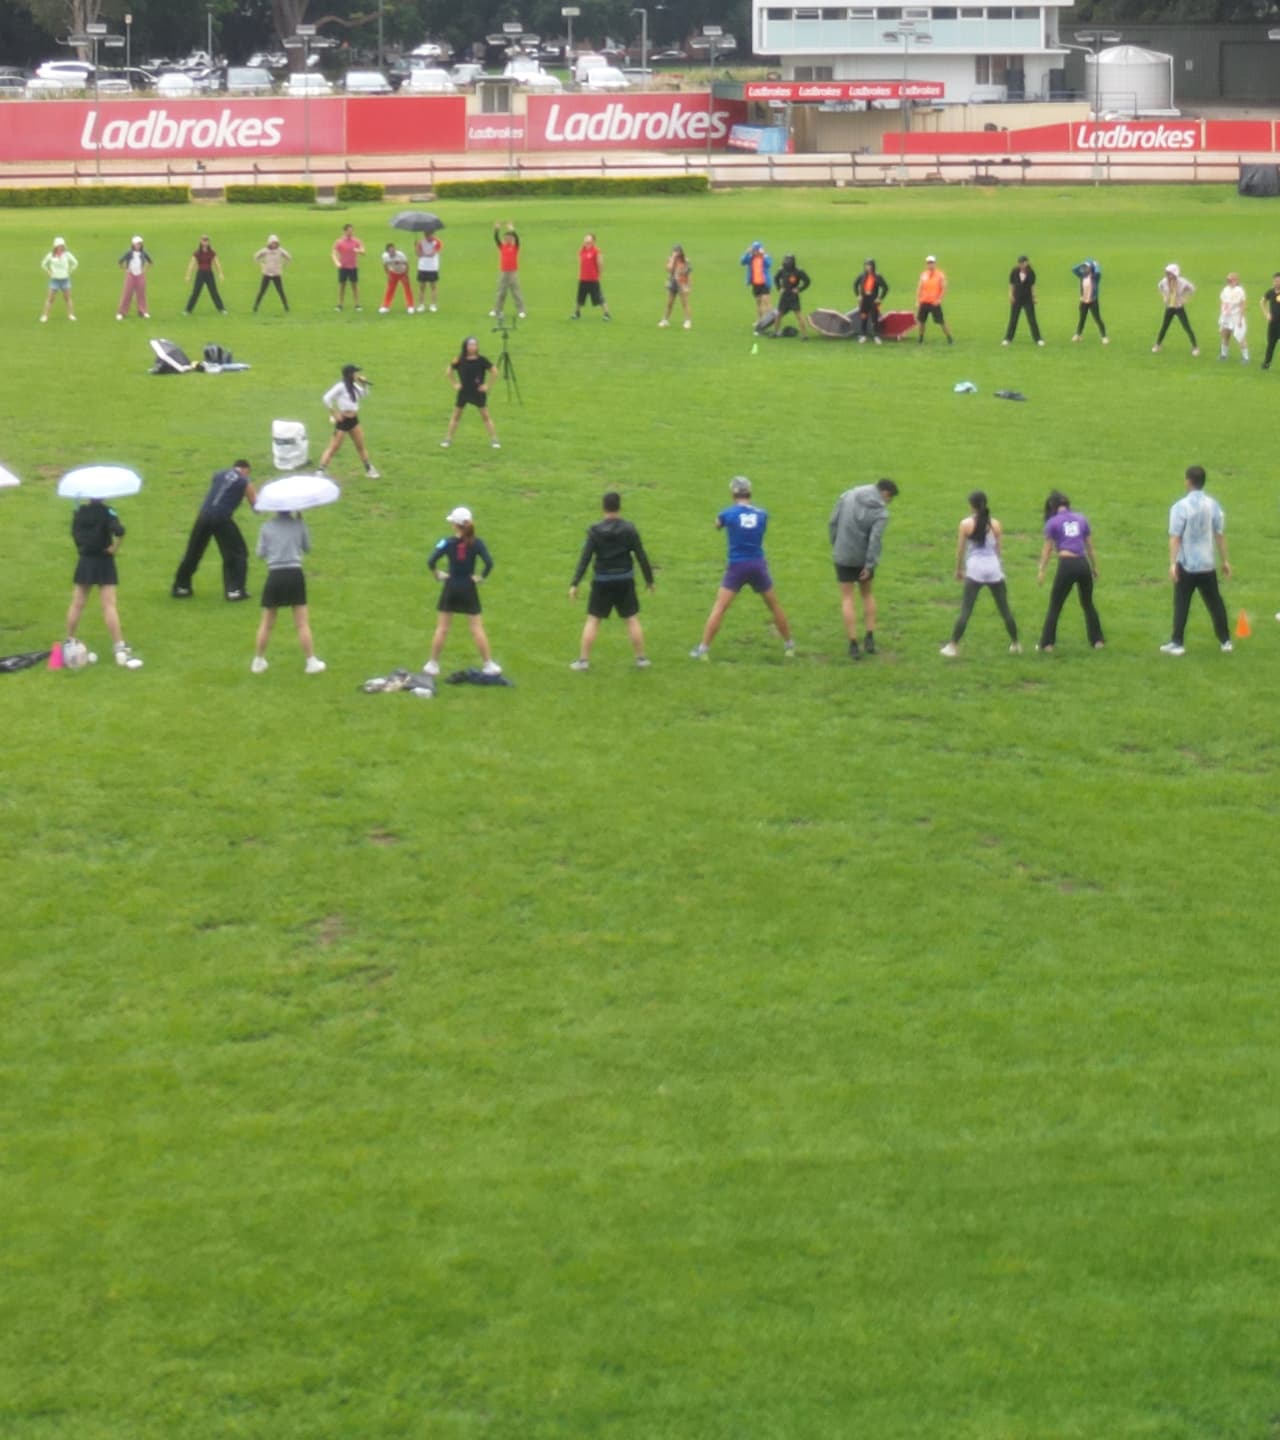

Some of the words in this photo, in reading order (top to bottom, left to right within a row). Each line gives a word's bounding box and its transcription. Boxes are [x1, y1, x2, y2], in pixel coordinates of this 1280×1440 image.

[80, 108, 285, 150] Ladbrokes
[545, 103, 730, 142] Ladbrokes
[1077, 124, 1196, 149] Ladbrokes
